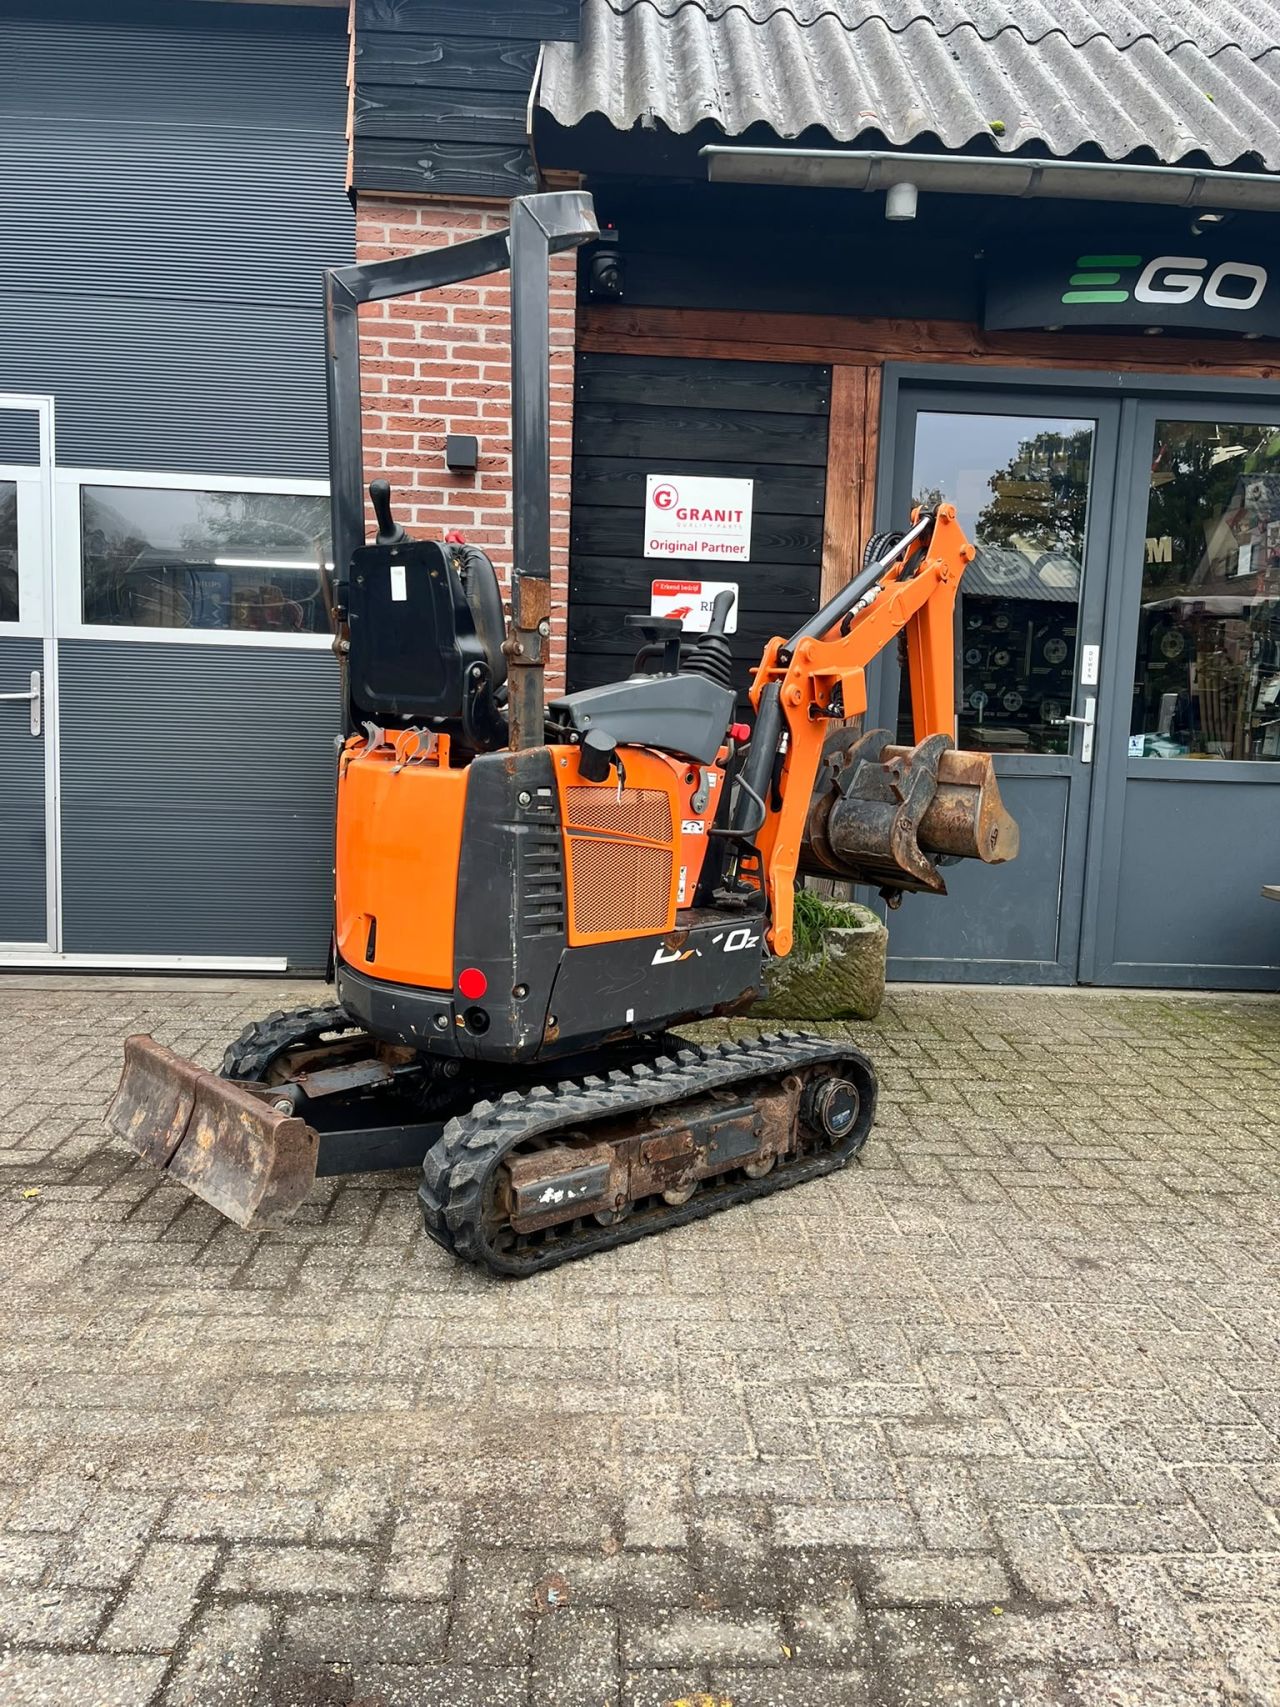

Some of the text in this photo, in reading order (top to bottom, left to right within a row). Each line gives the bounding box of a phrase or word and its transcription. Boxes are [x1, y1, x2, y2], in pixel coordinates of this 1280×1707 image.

[1062, 255, 1267, 309] EGO
[655, 490, 672, 507] G
[676, 508, 743, 522] GRANIT
[650, 539, 745, 554] Original Partner
